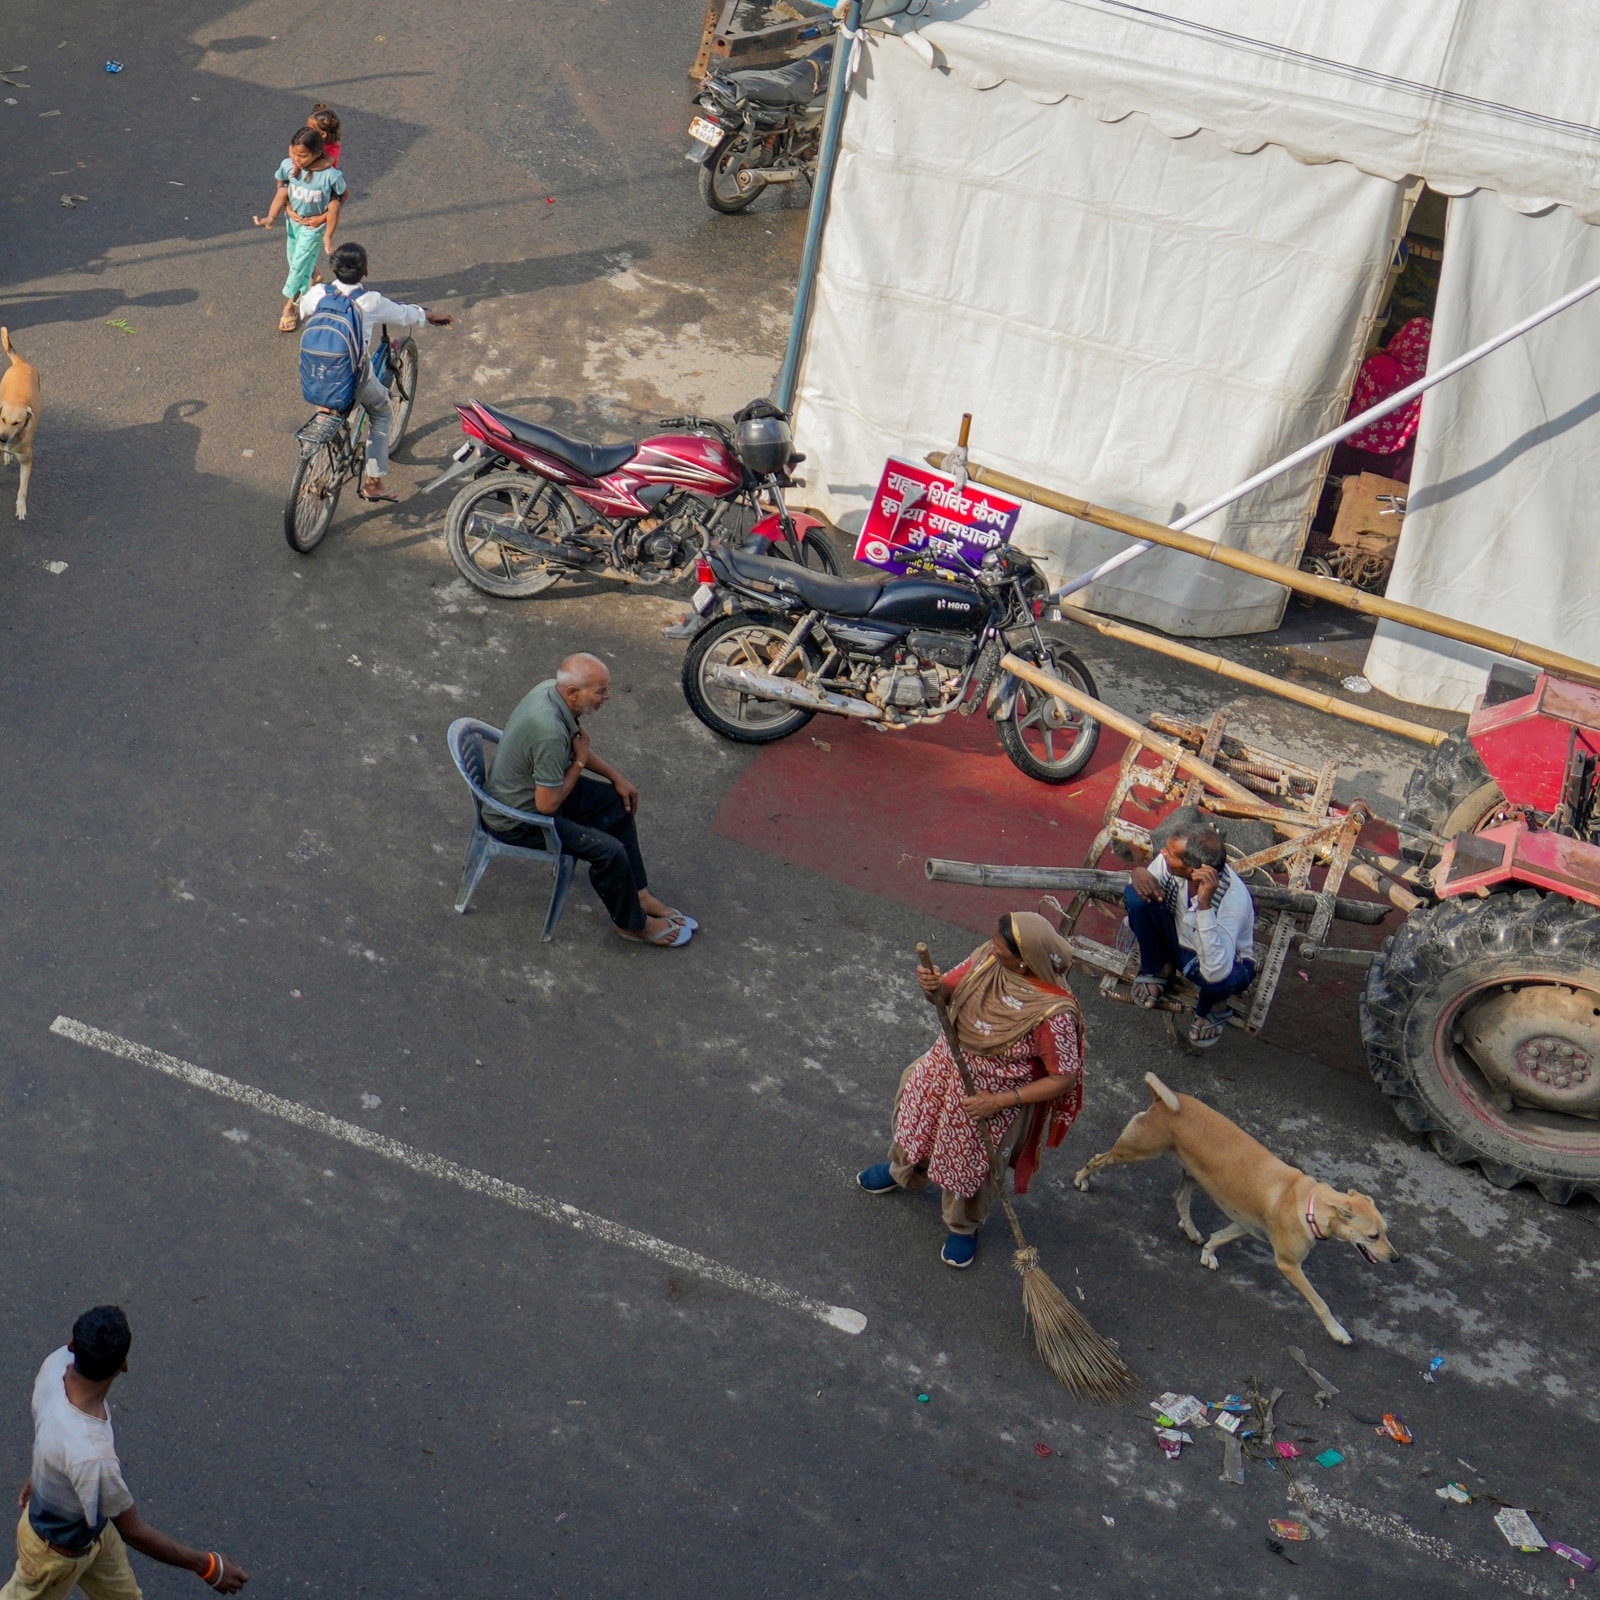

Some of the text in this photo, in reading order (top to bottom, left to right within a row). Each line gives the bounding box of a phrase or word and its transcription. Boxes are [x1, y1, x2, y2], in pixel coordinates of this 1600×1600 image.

[291, 184, 322, 202] LOVE
[888, 471, 926, 496] राह
[972, 498, 1010, 529] कैम्प
[908, 526, 926, 546] से
[927, 512, 1002, 548] सावधानी
